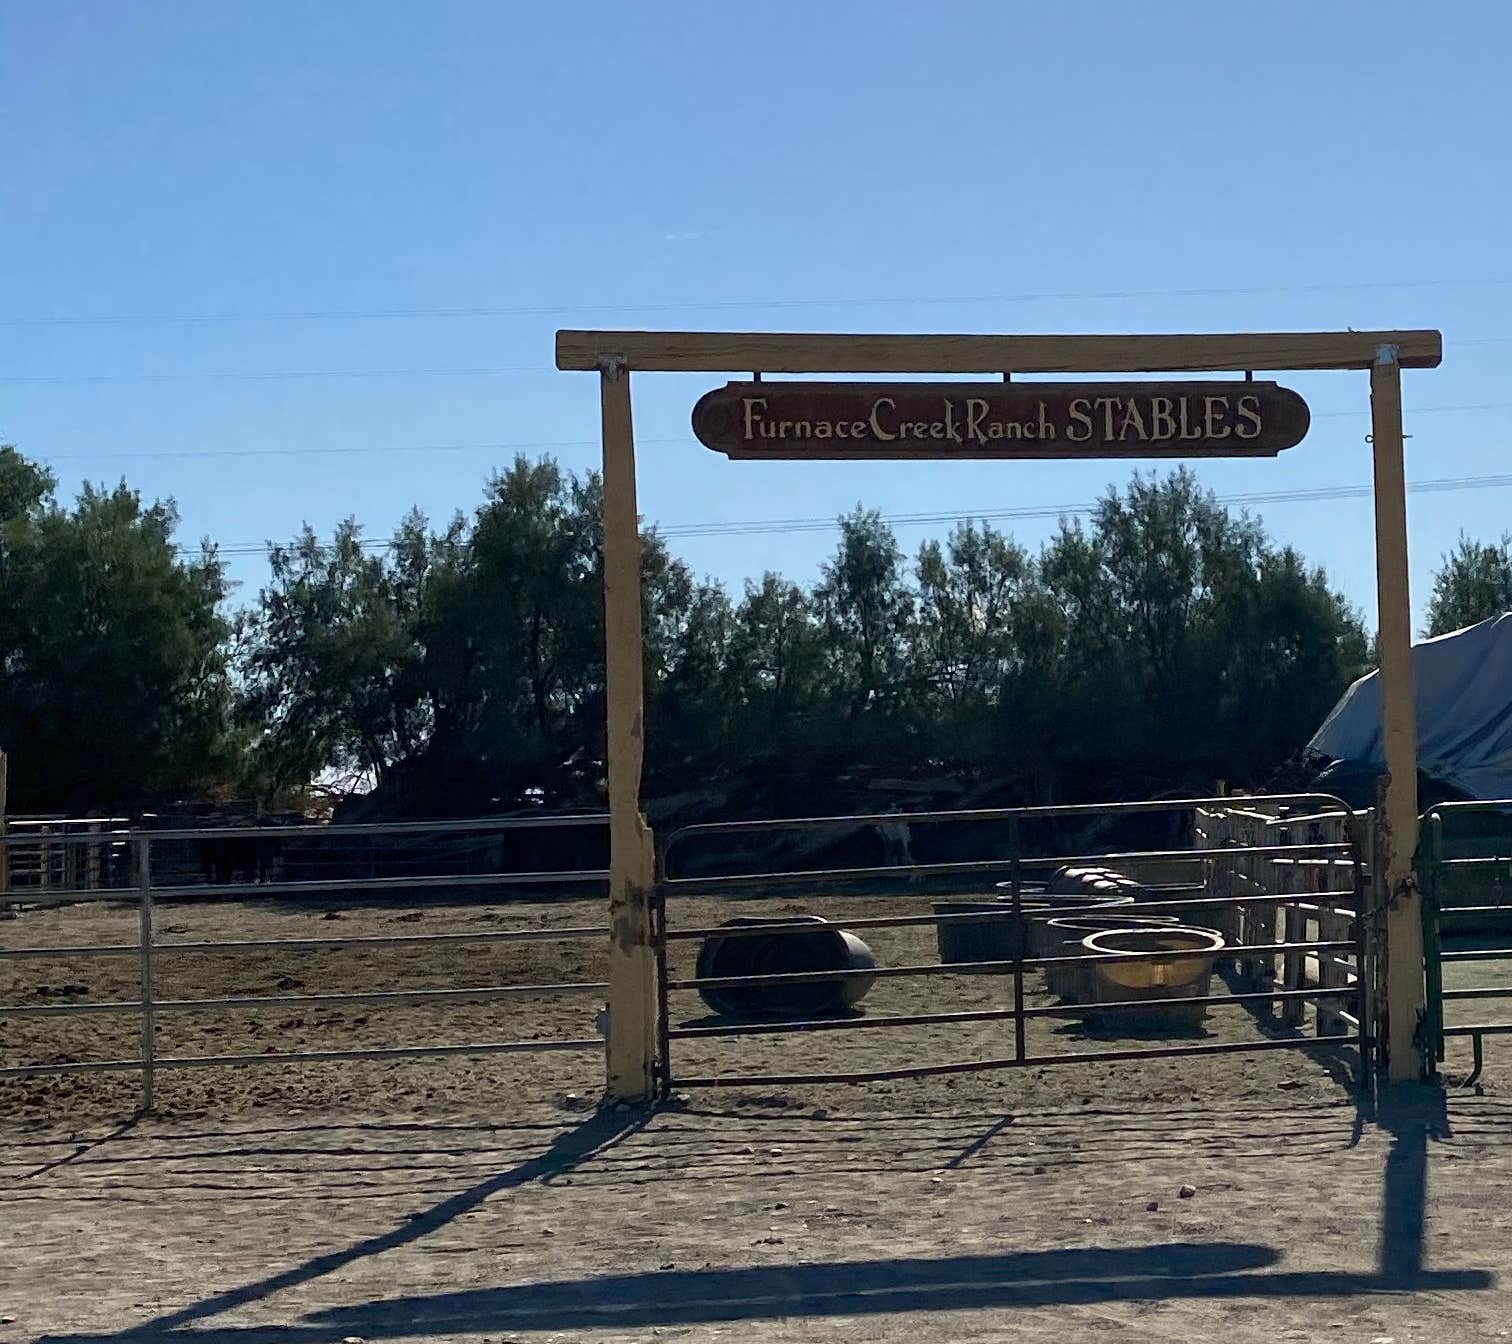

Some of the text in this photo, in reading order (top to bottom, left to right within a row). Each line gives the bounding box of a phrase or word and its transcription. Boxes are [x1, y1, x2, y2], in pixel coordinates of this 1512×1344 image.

[741, 395, 1263, 447] Furnace Creek Ranch STABLES
